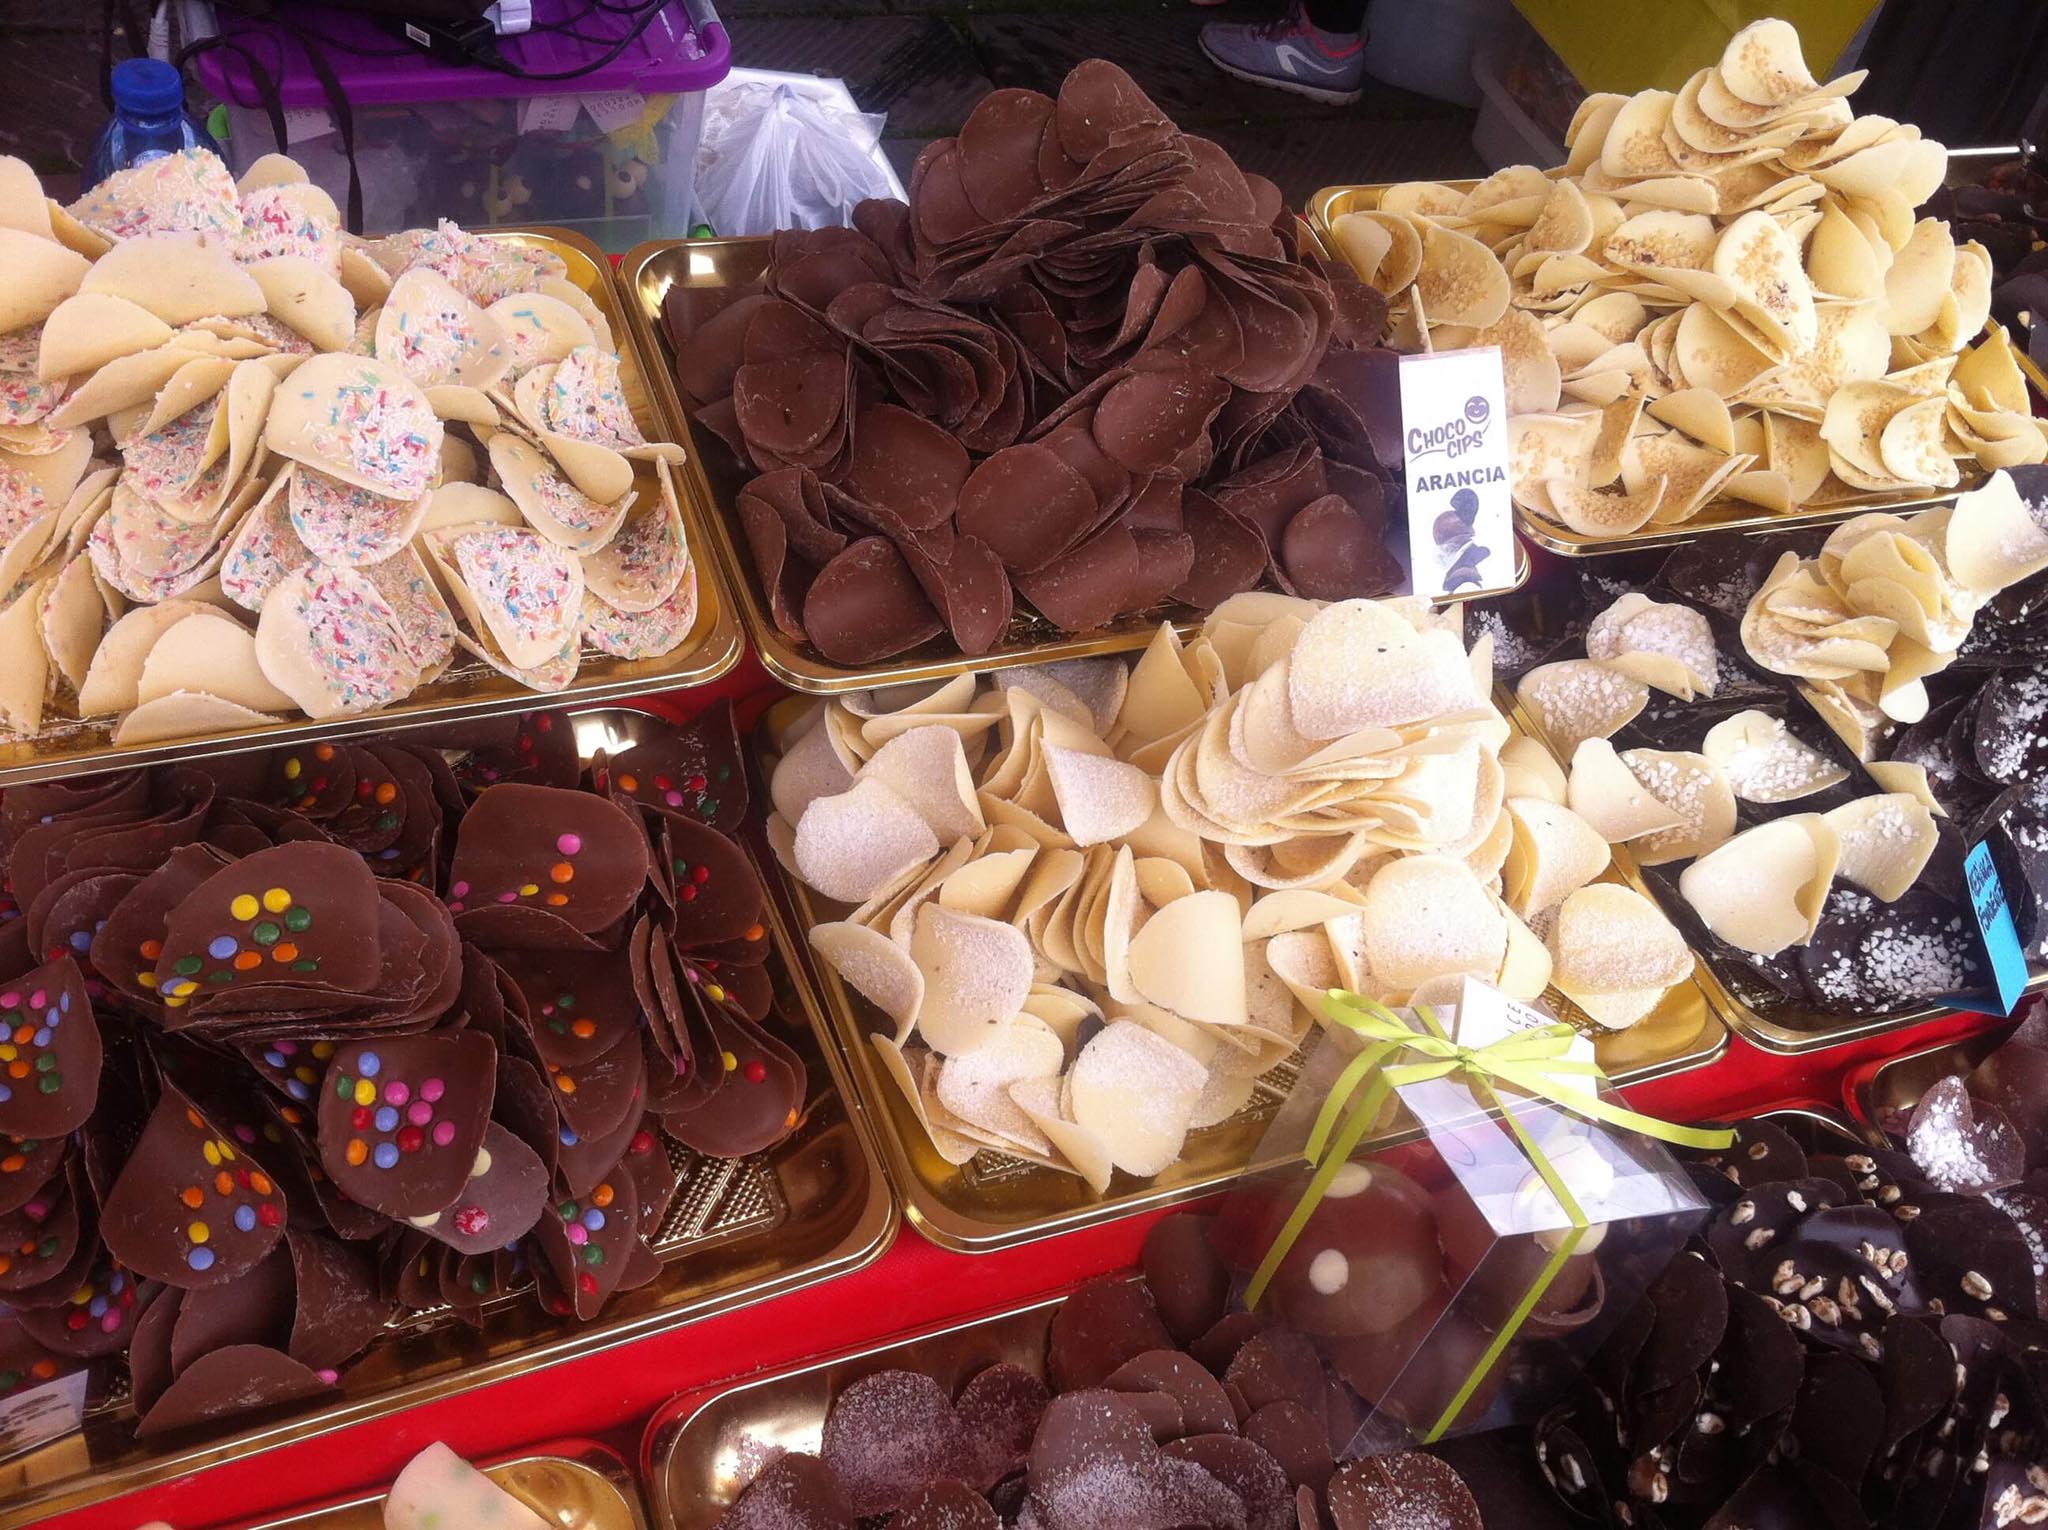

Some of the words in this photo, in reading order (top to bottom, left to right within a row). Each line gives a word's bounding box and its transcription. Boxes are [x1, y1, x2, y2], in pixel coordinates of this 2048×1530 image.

[1408, 418, 1466, 454] CHOCO
[1447, 430, 1484, 458] CIPS
[1416, 466, 1506, 493] ARANCIA
